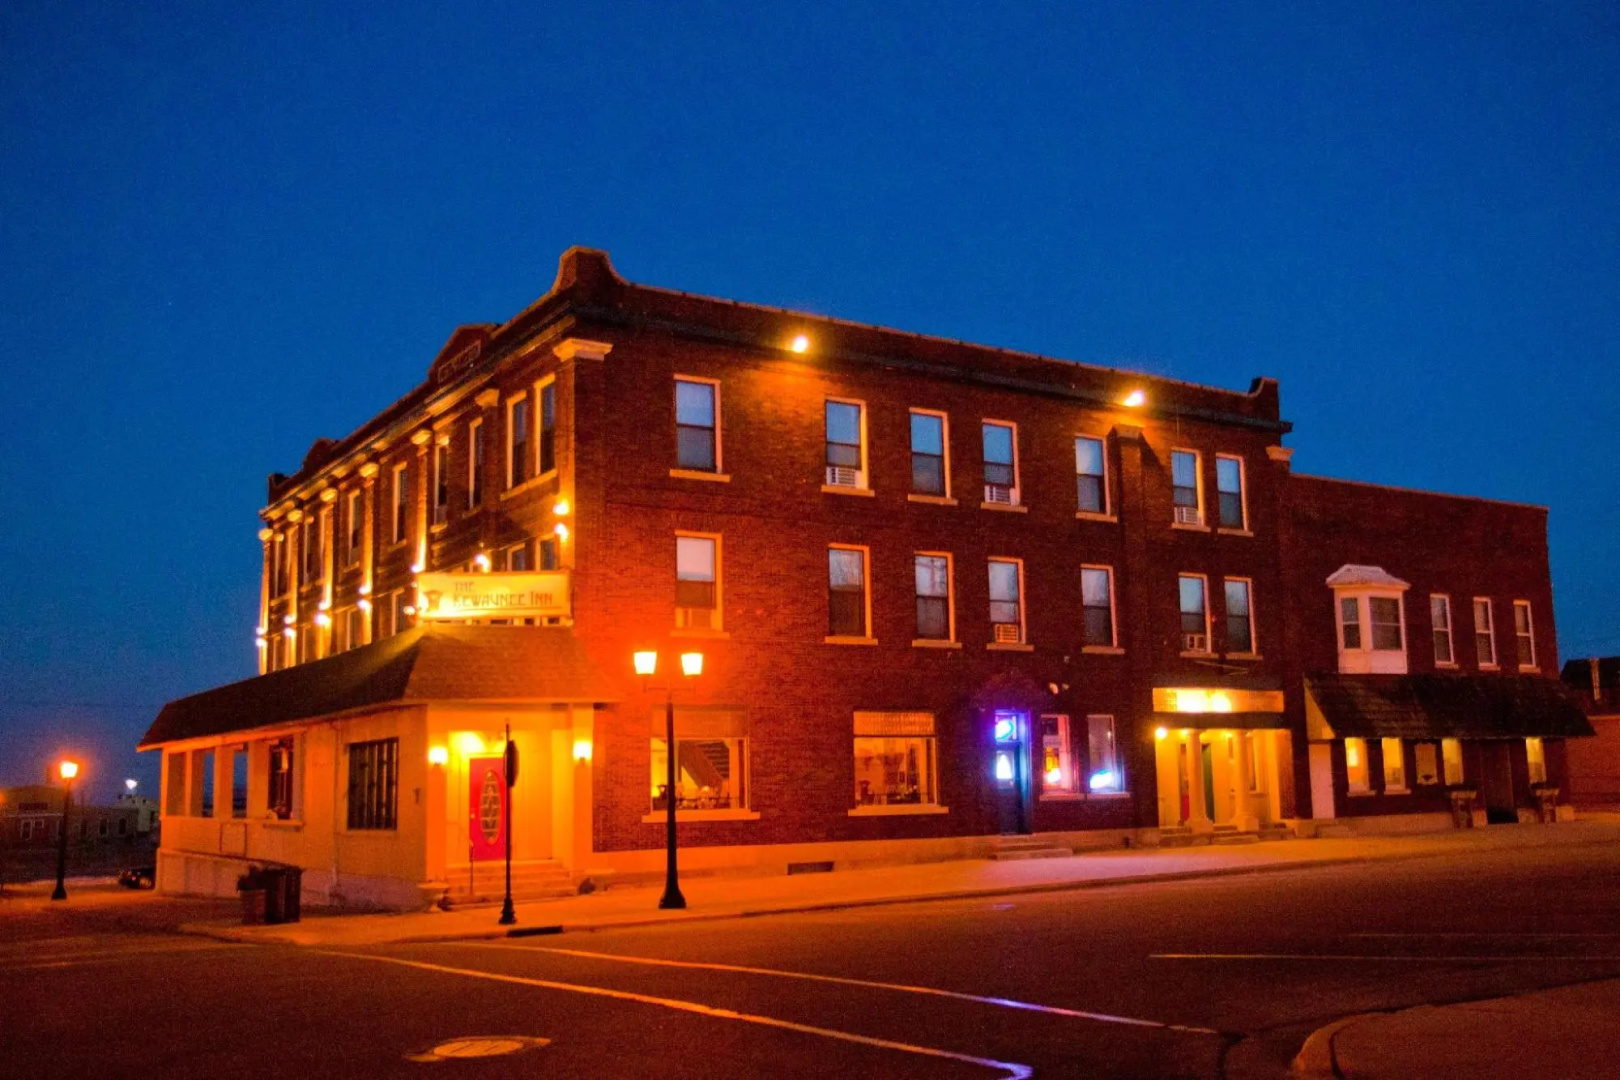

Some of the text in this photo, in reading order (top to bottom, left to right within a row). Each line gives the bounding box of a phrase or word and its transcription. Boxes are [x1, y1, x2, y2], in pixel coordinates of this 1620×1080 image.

[454, 581, 475, 593] THE
[453, 591, 553, 607] KEWAUNEE INN
